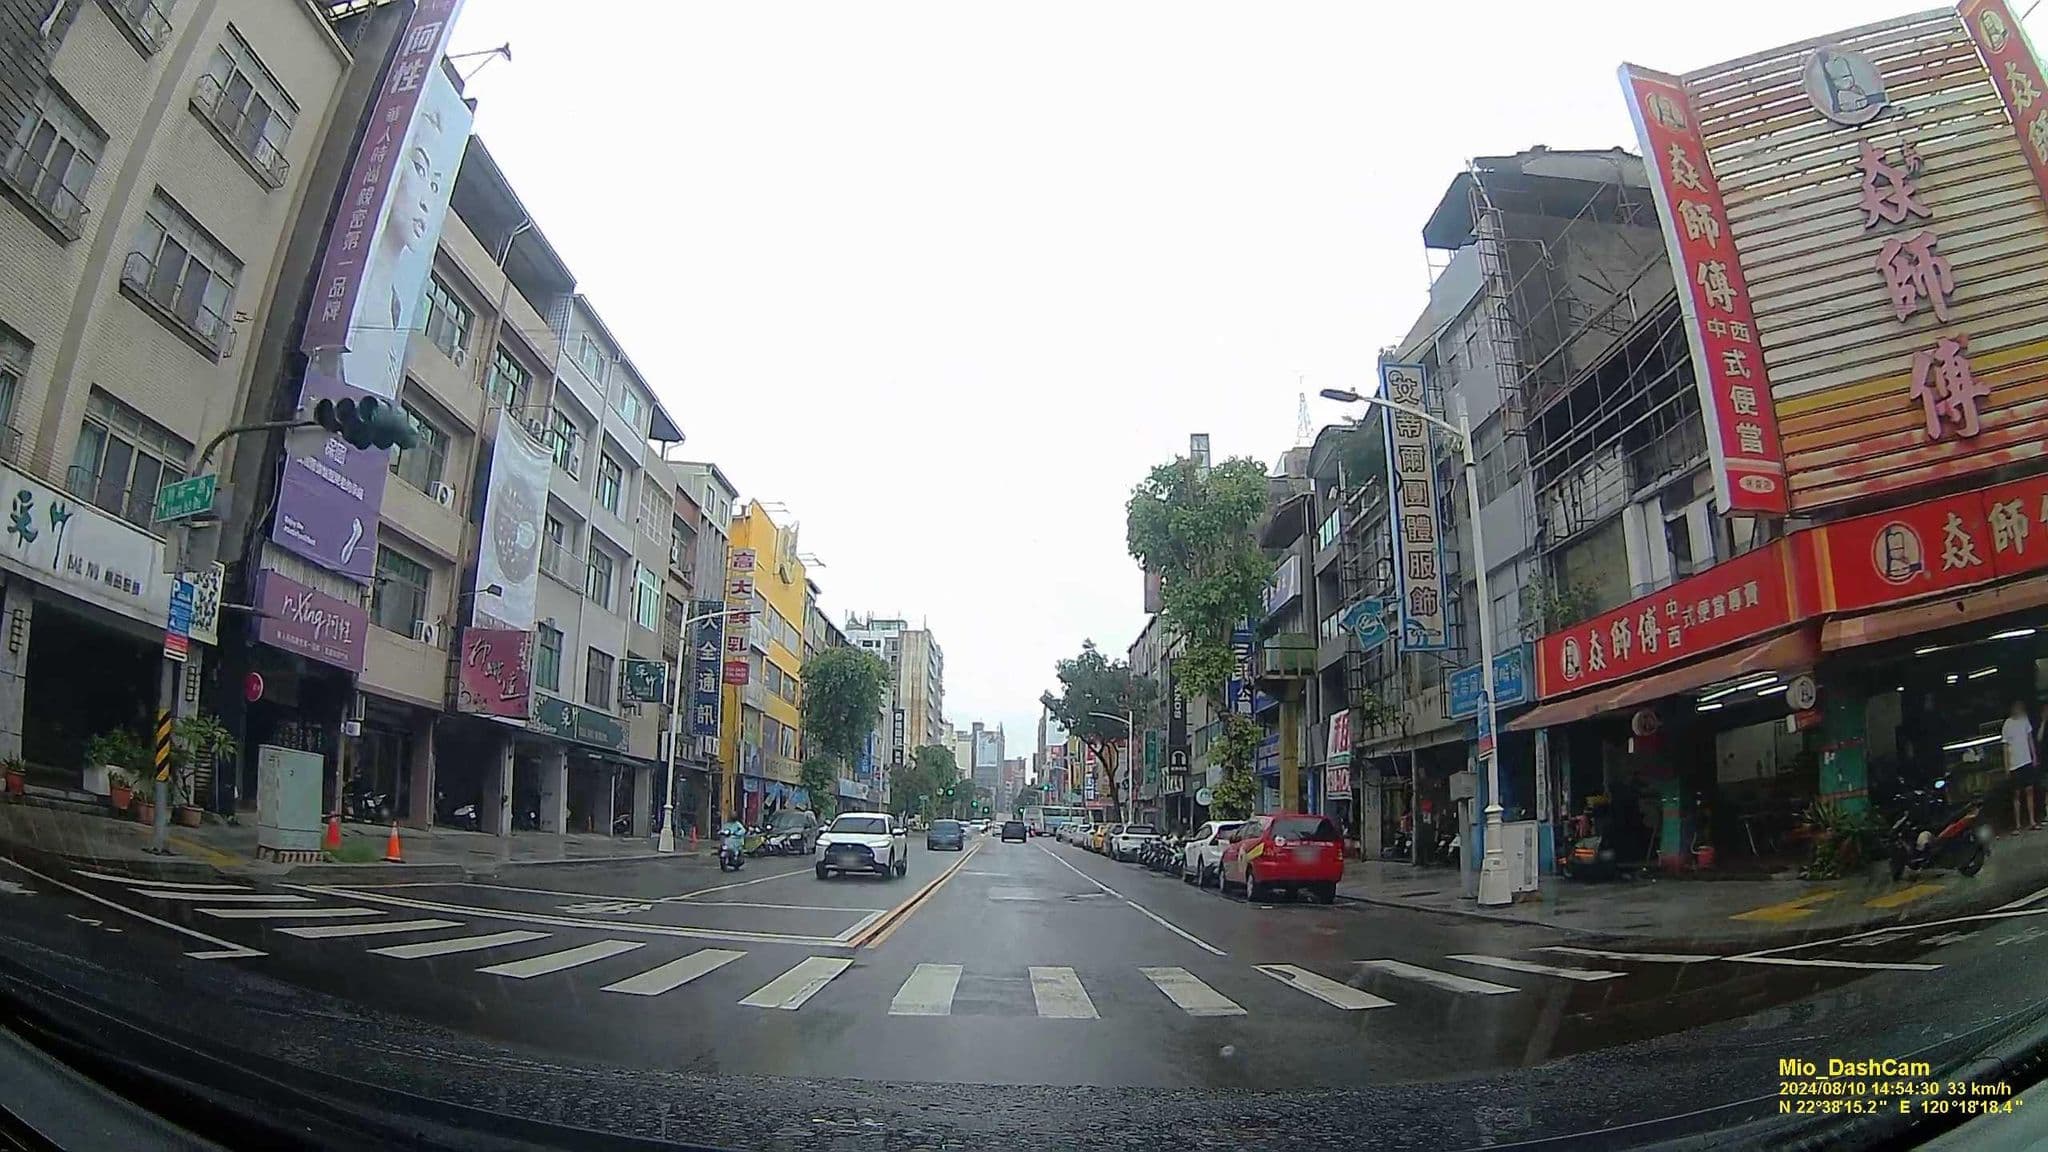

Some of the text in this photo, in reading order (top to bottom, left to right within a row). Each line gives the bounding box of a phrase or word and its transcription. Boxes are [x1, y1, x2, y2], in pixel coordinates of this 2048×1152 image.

[728, 552, 755, 653] 高大鮮乳
[698, 609, 718, 726] 大全通訊
